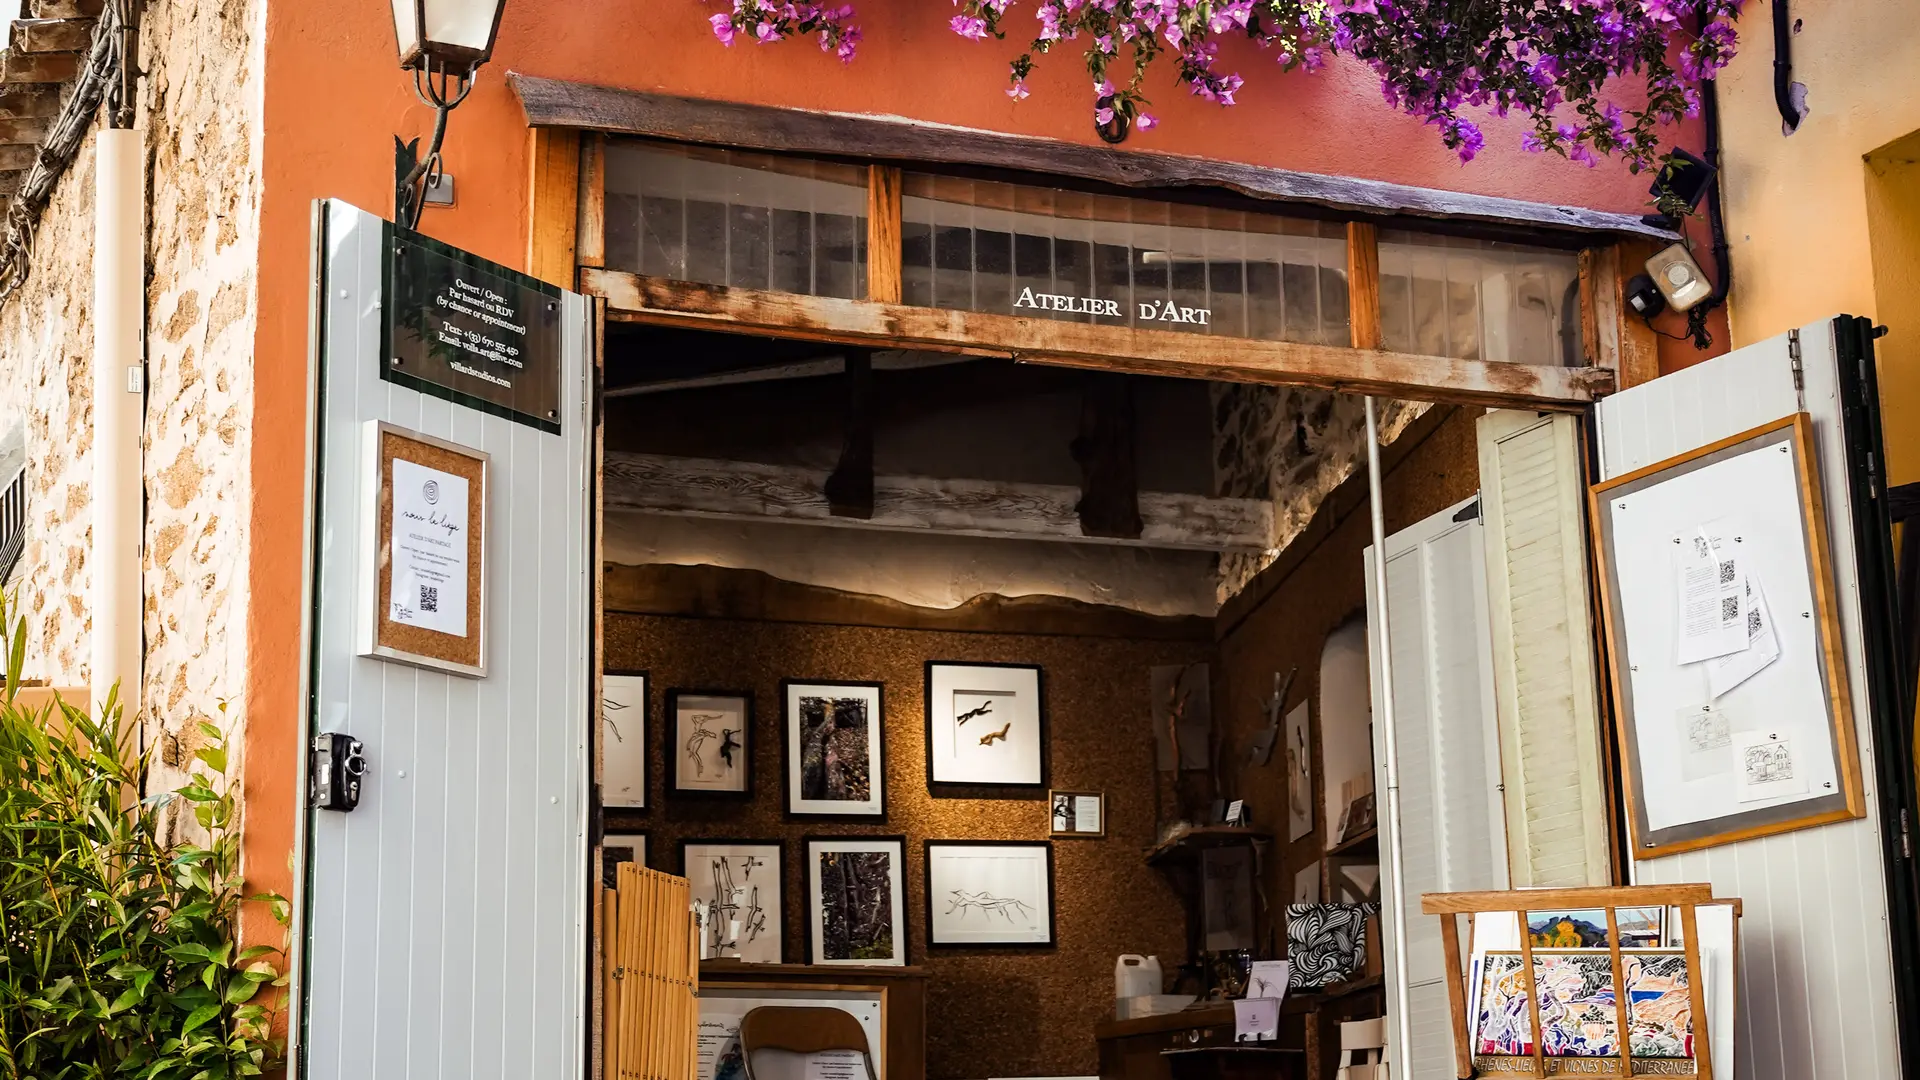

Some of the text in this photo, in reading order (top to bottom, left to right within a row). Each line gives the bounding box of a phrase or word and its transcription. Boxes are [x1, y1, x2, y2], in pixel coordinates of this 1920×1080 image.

[456, 278, 480, 294] Ouvert
[437, 295, 448, 308] (by
[449, 301, 473, 315] chance
[481, 313, 526, 335] appointment)
[449, 287, 514, 318] Par hasard ou RDV
[1013, 286, 1212, 325] ATELIER D'ART
[438, 331, 462, 347] Email:
[443, 321, 462, 336] Text:
[482, 336, 494, 347] 670
[495, 342, 506, 353] 555
[506, 346, 519, 356] 450
[450, 361, 511, 388] villardstudios.com
[1550, 1058, 1563, 1072] ET
[1564, 1059, 1600, 1074] VIGNES
[1602, 1059, 1616, 1074] DE
